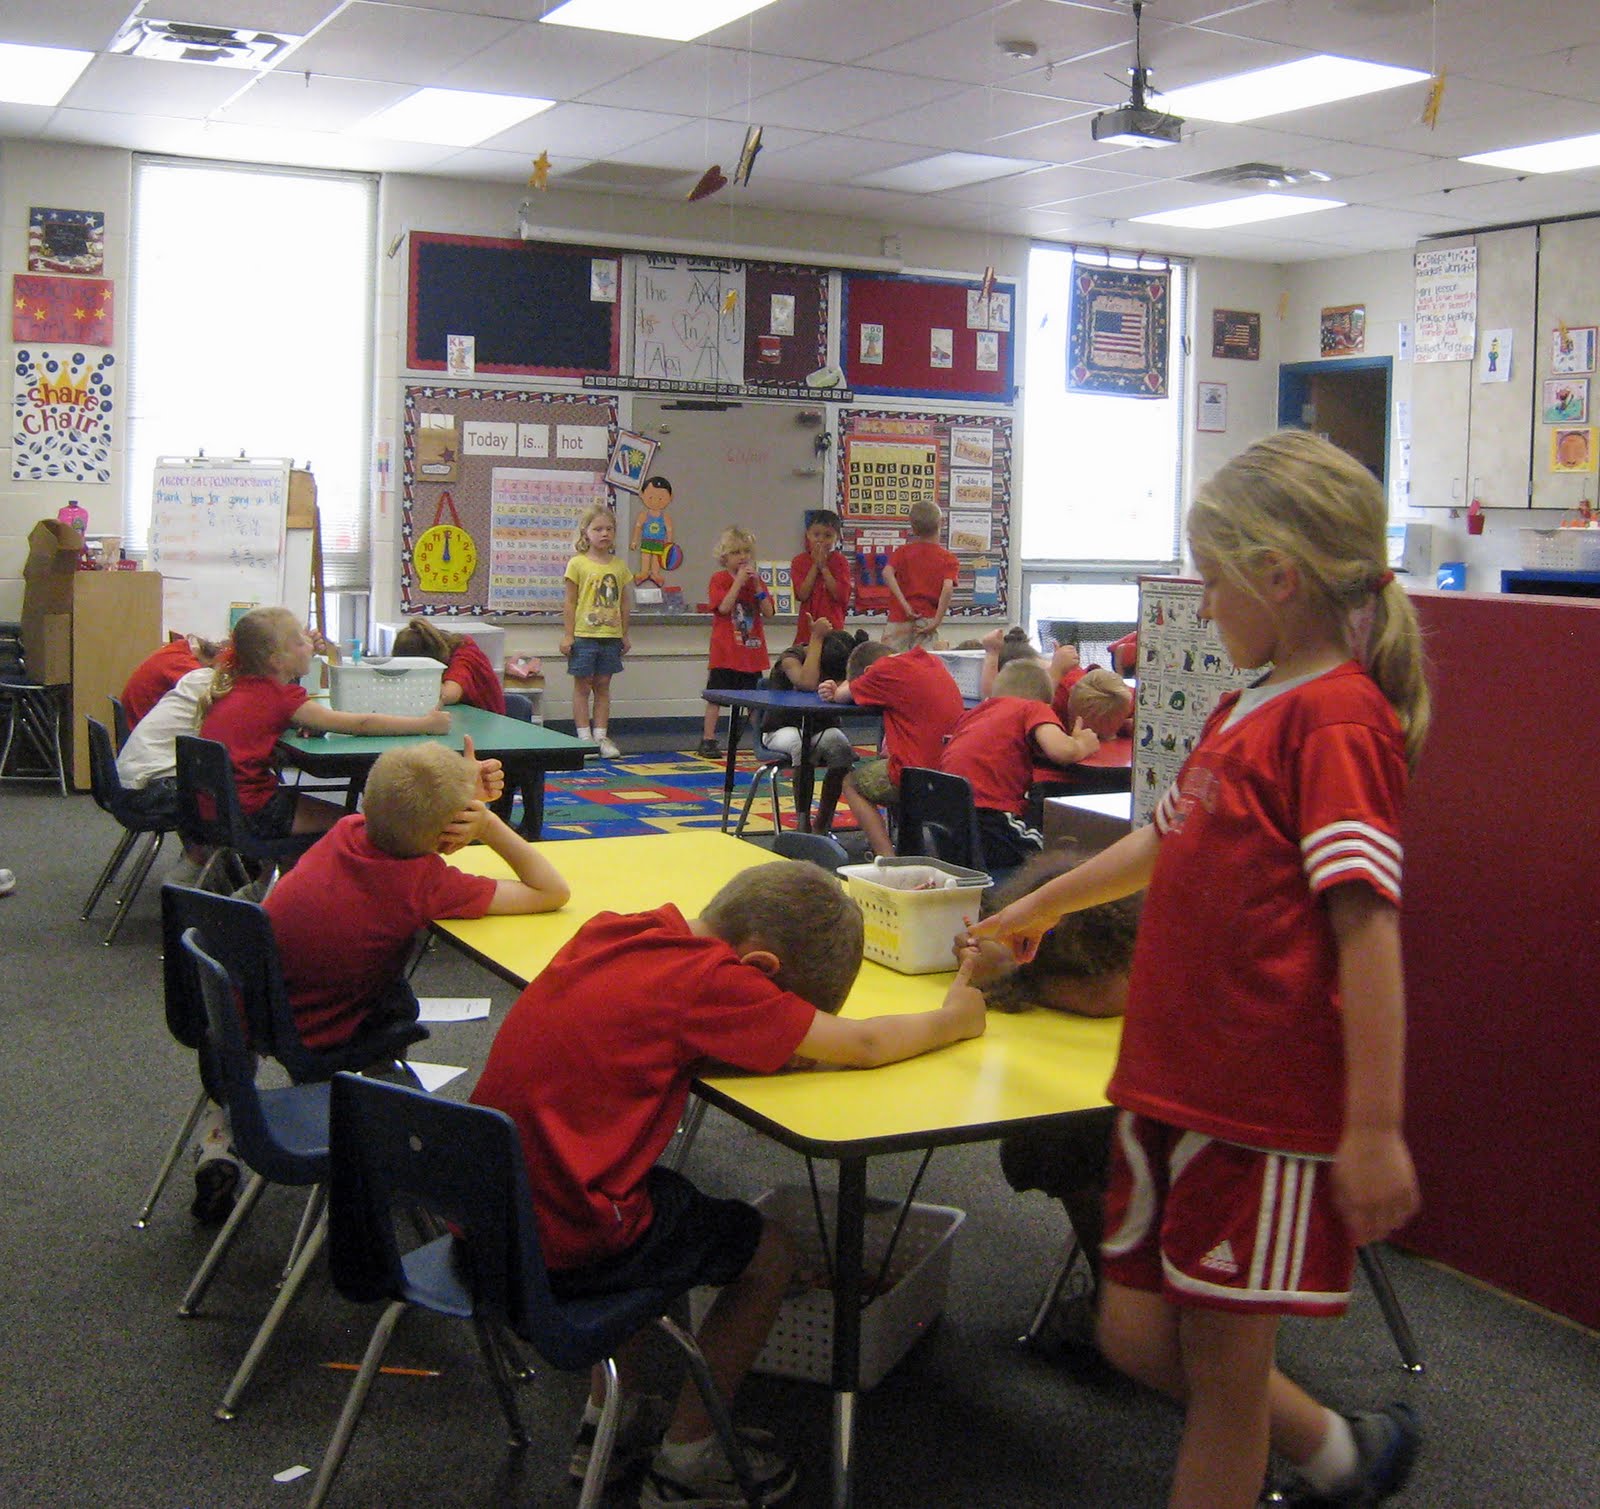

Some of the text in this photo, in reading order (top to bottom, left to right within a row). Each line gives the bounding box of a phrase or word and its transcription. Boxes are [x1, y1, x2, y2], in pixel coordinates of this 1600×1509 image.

[22, 408, 99, 435] Chair
[468, 431, 584, 453] Today is... hot
[432, 534, 440, 542] 11
[457, 534, 460, 542] 1
[424, 542, 434, 552] 10
[464, 542, 469, 550] 2
[421, 552, 427, 562] 9
[466, 554, 472, 563] 3
[424, 564, 430, 572] 8
[462, 566, 468, 574] 4
[432, 572, 438, 580] 7
[442, 575, 448, 584] 6
[453, 572, 459, 582] 5
